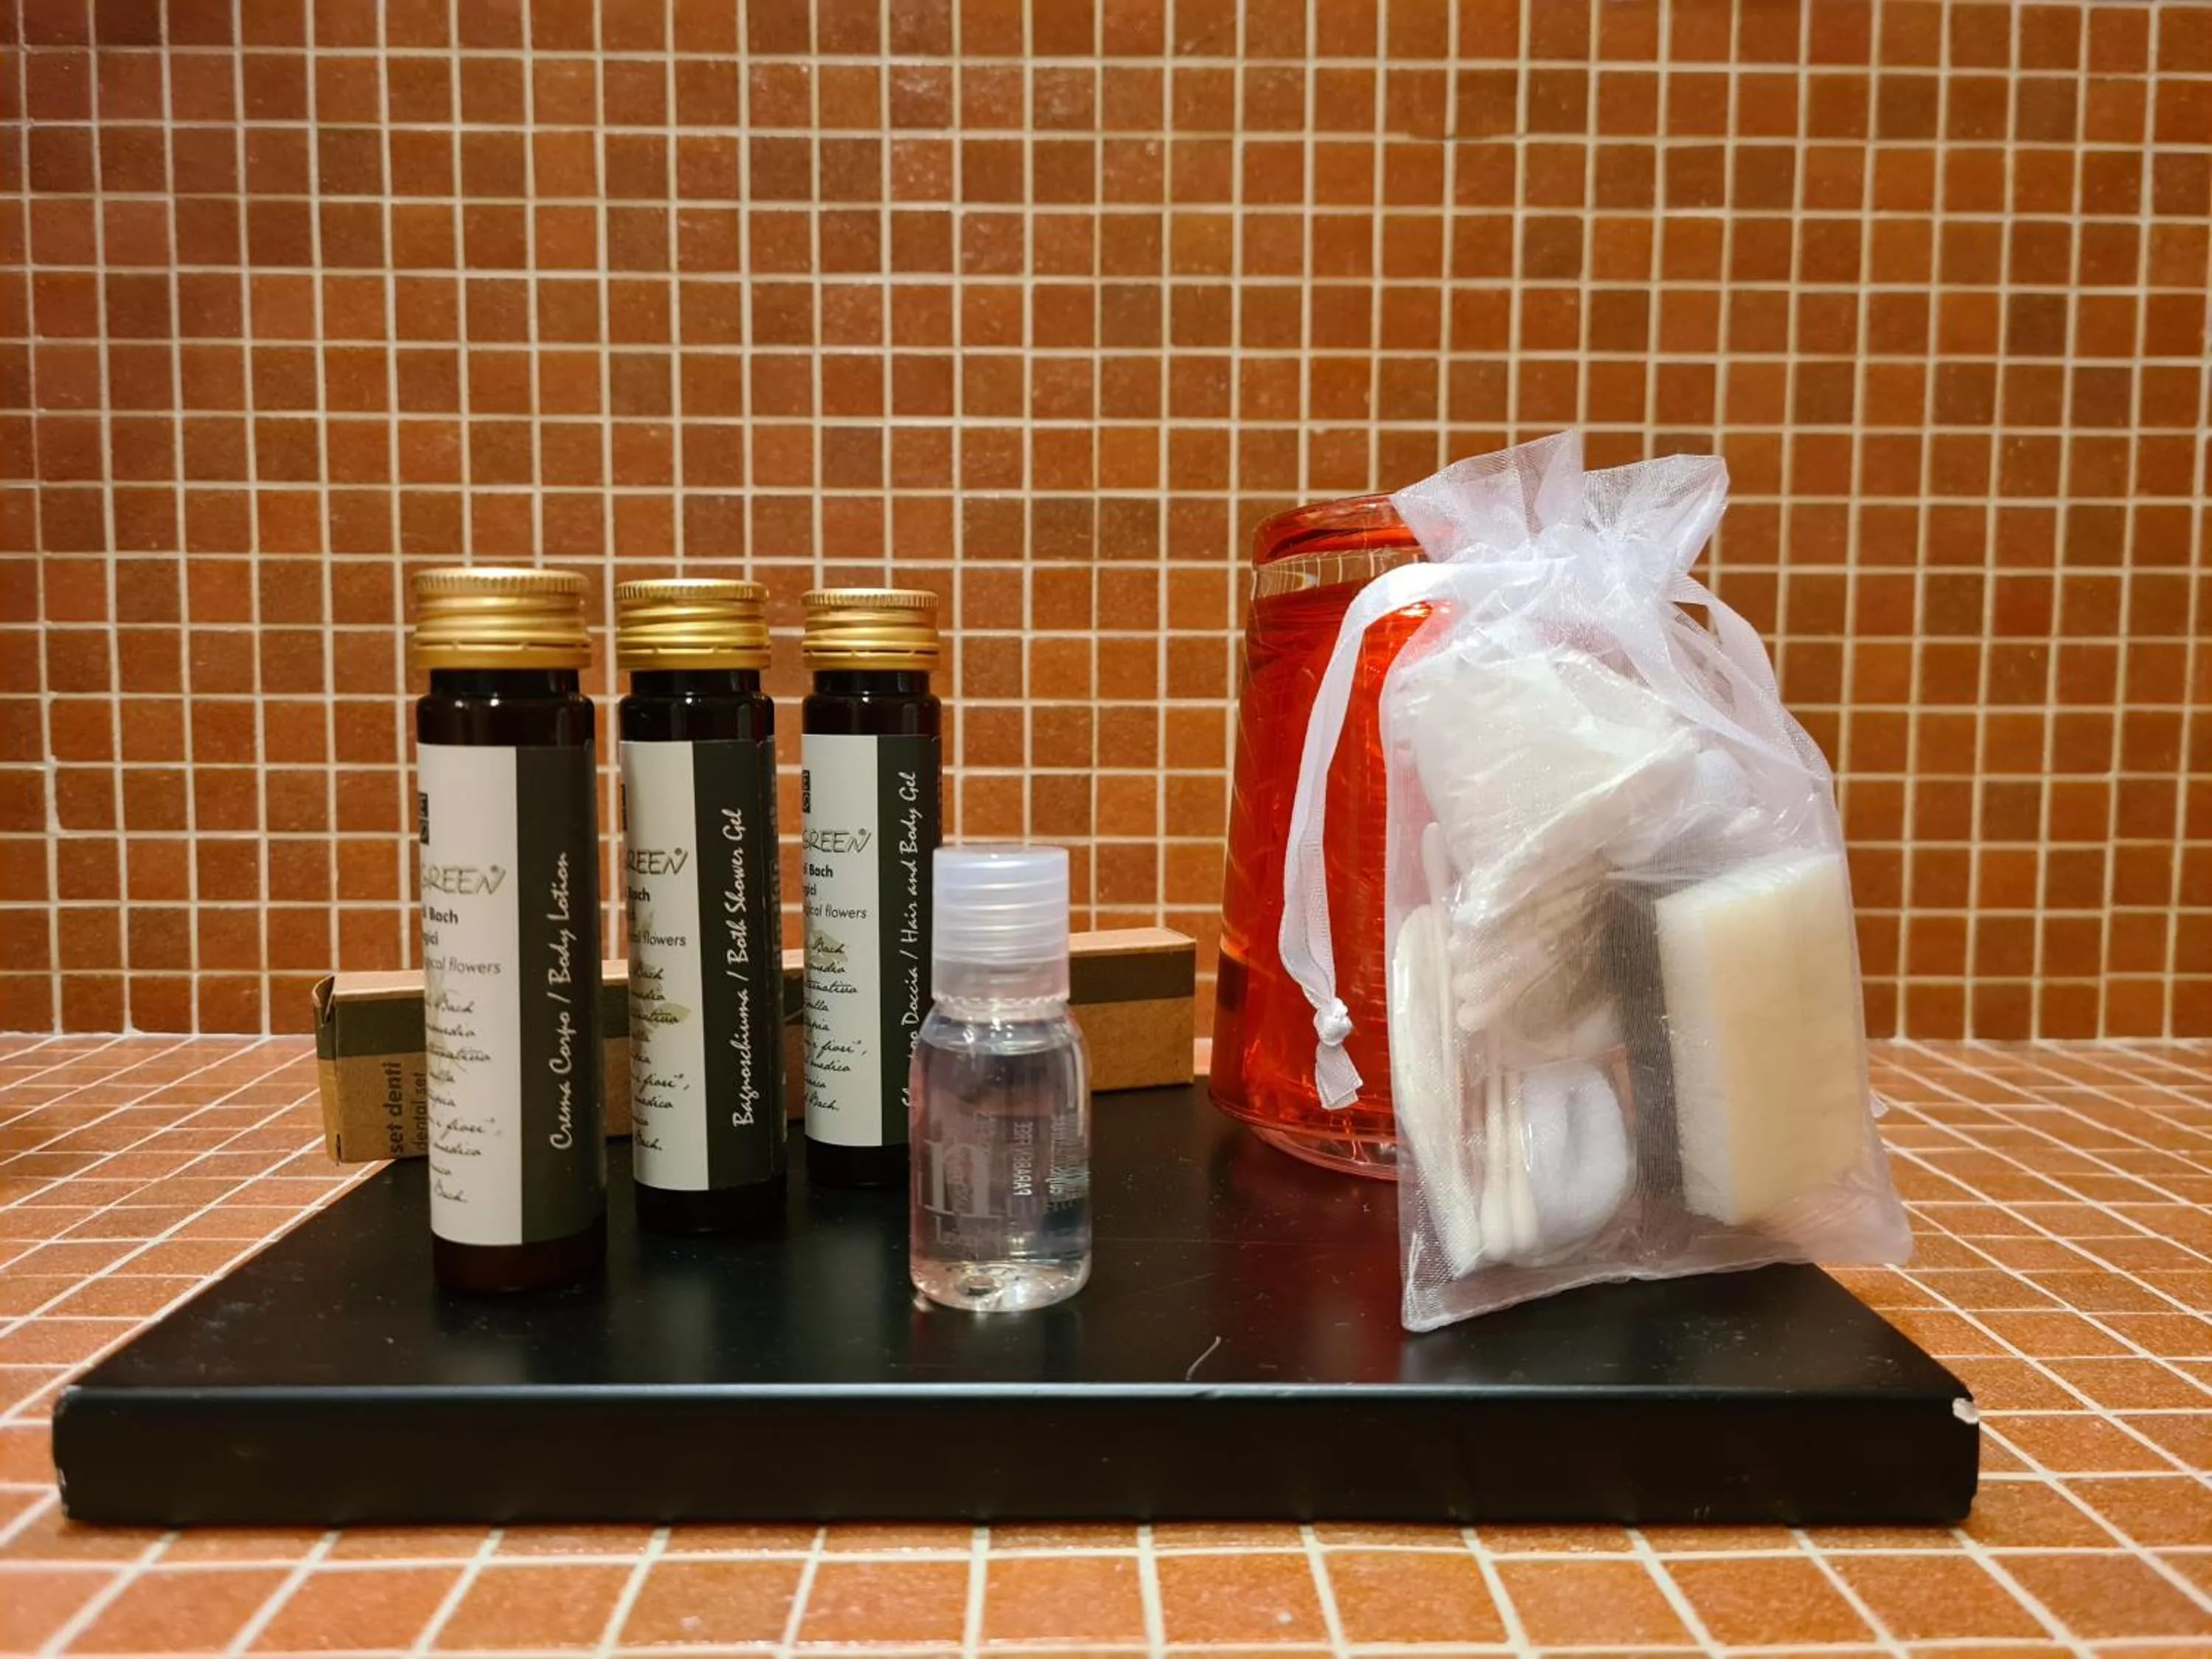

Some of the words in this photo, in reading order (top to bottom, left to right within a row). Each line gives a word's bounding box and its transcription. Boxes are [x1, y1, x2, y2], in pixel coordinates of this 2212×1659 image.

[897, 771, 920, 802] Gel
[720, 808, 747, 841] Gel
[899, 807, 923, 854] Body
[422, 864, 507, 895] REEN
[628, 847, 689, 875] REEN
[723, 847, 747, 913] Shower
[809, 863, 834, 877] Bach
[899, 860, 919, 898] and
[546, 851, 569, 921] Lotion
[825, 904, 868, 919] flowers
[900, 901, 919, 943] Hair
[548, 927, 577, 984] Body
[643, 930, 687, 947] flowers
[726, 919, 750, 965] Bath
[449, 956, 502, 975] flowers
[901, 967, 921, 1026] Doccia
[549, 1011, 577, 1076] Corpo
[730, 989, 759, 1127] Bagnoschiuma
[382, 1062, 403, 1117] denti
[413, 1071, 427, 1096] set
[550, 1080, 573, 1150] Crema
[386, 1123, 404, 1154] set
